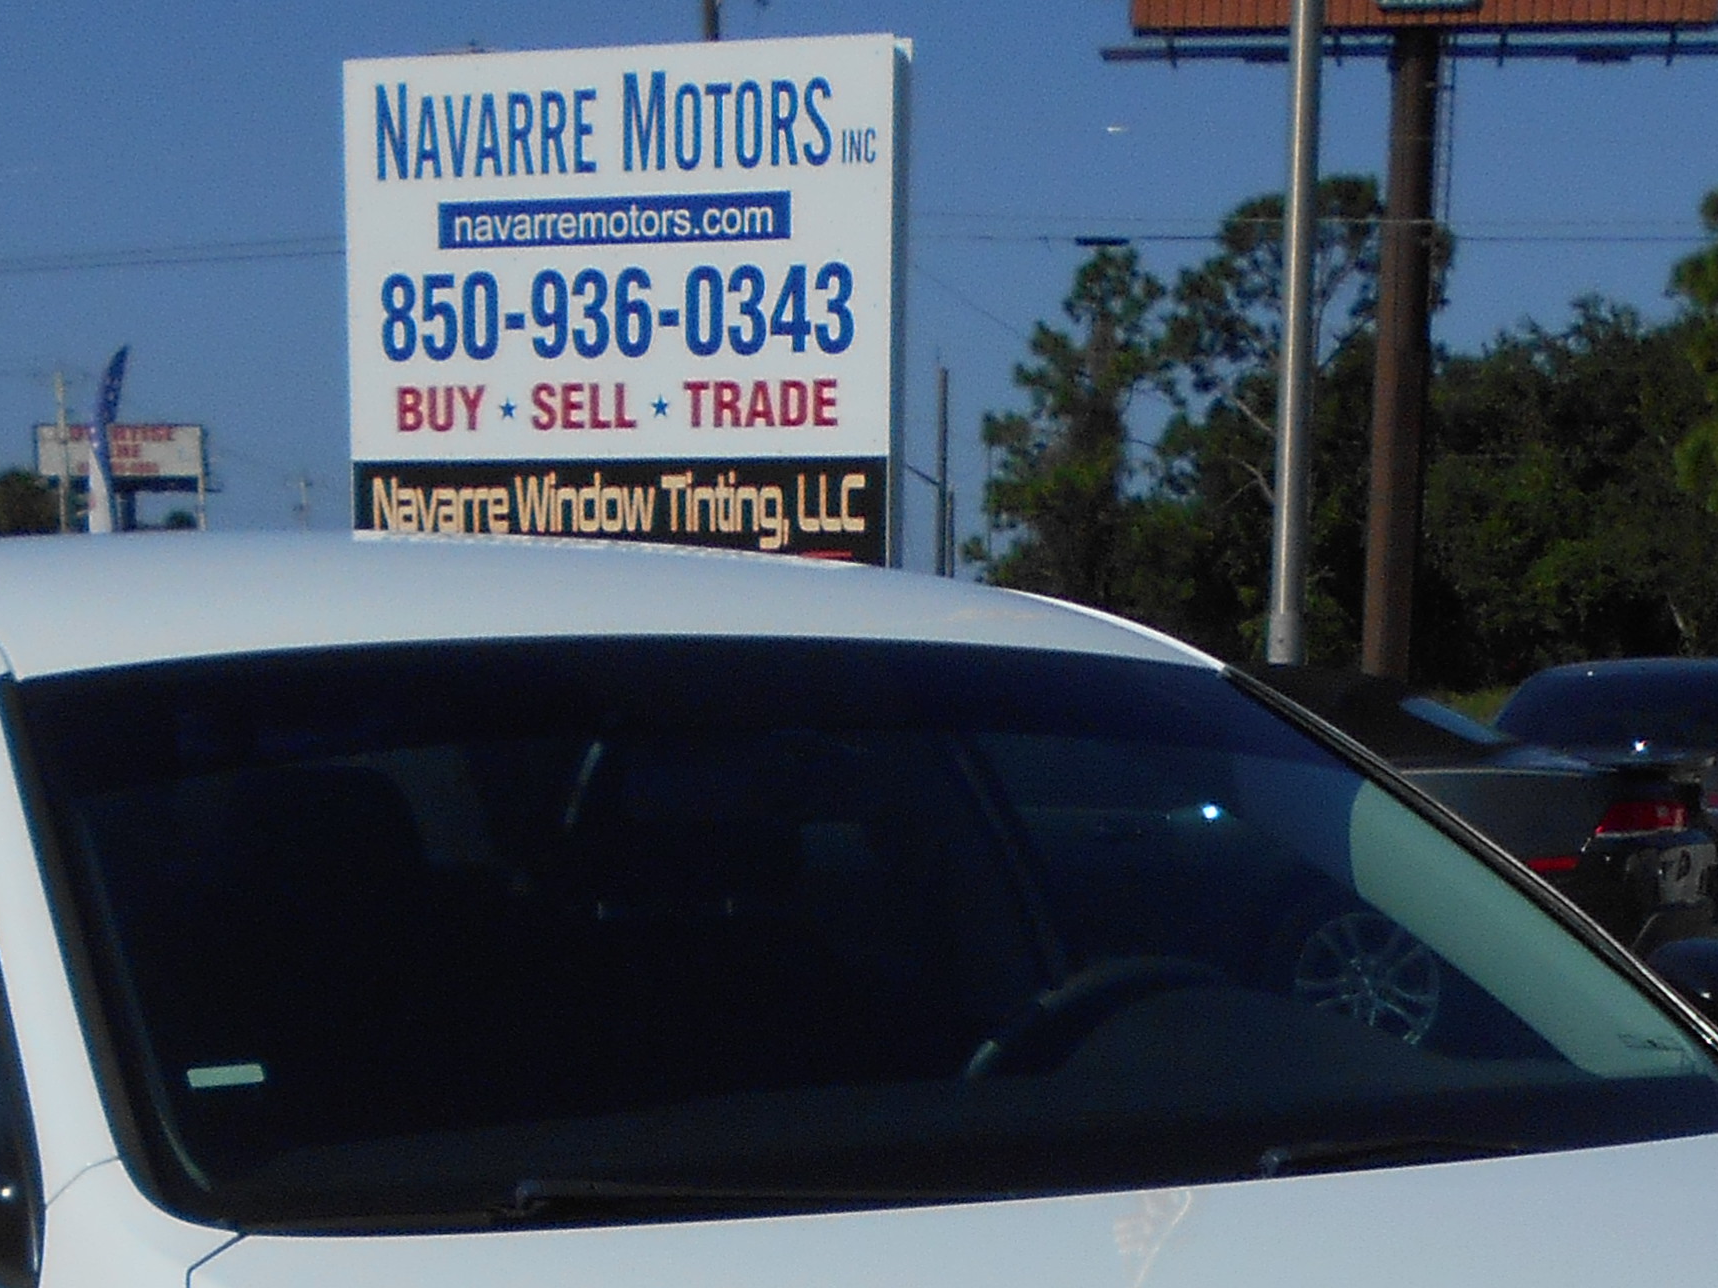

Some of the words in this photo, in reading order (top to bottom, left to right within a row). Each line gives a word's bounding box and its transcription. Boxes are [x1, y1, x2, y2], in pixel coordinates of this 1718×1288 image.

[375, 82, 597, 181] NAVARRE
[622, 70, 832, 172] MOTORS
[840, 129, 877, 165] INC
[454, 203, 774, 243] navarremotors.com
[381, 261, 854, 362] 850-936-0343
[395, 384, 486, 432] BUY
[530, 382, 638, 431] SELL
[683, 378, 839, 428] TRADE
[372, 474, 510, 533] Navarre
[514, 473, 656, 533] Window
[661, 472, 790, 550] Tinting,
[797, 472, 866, 533] LLC
